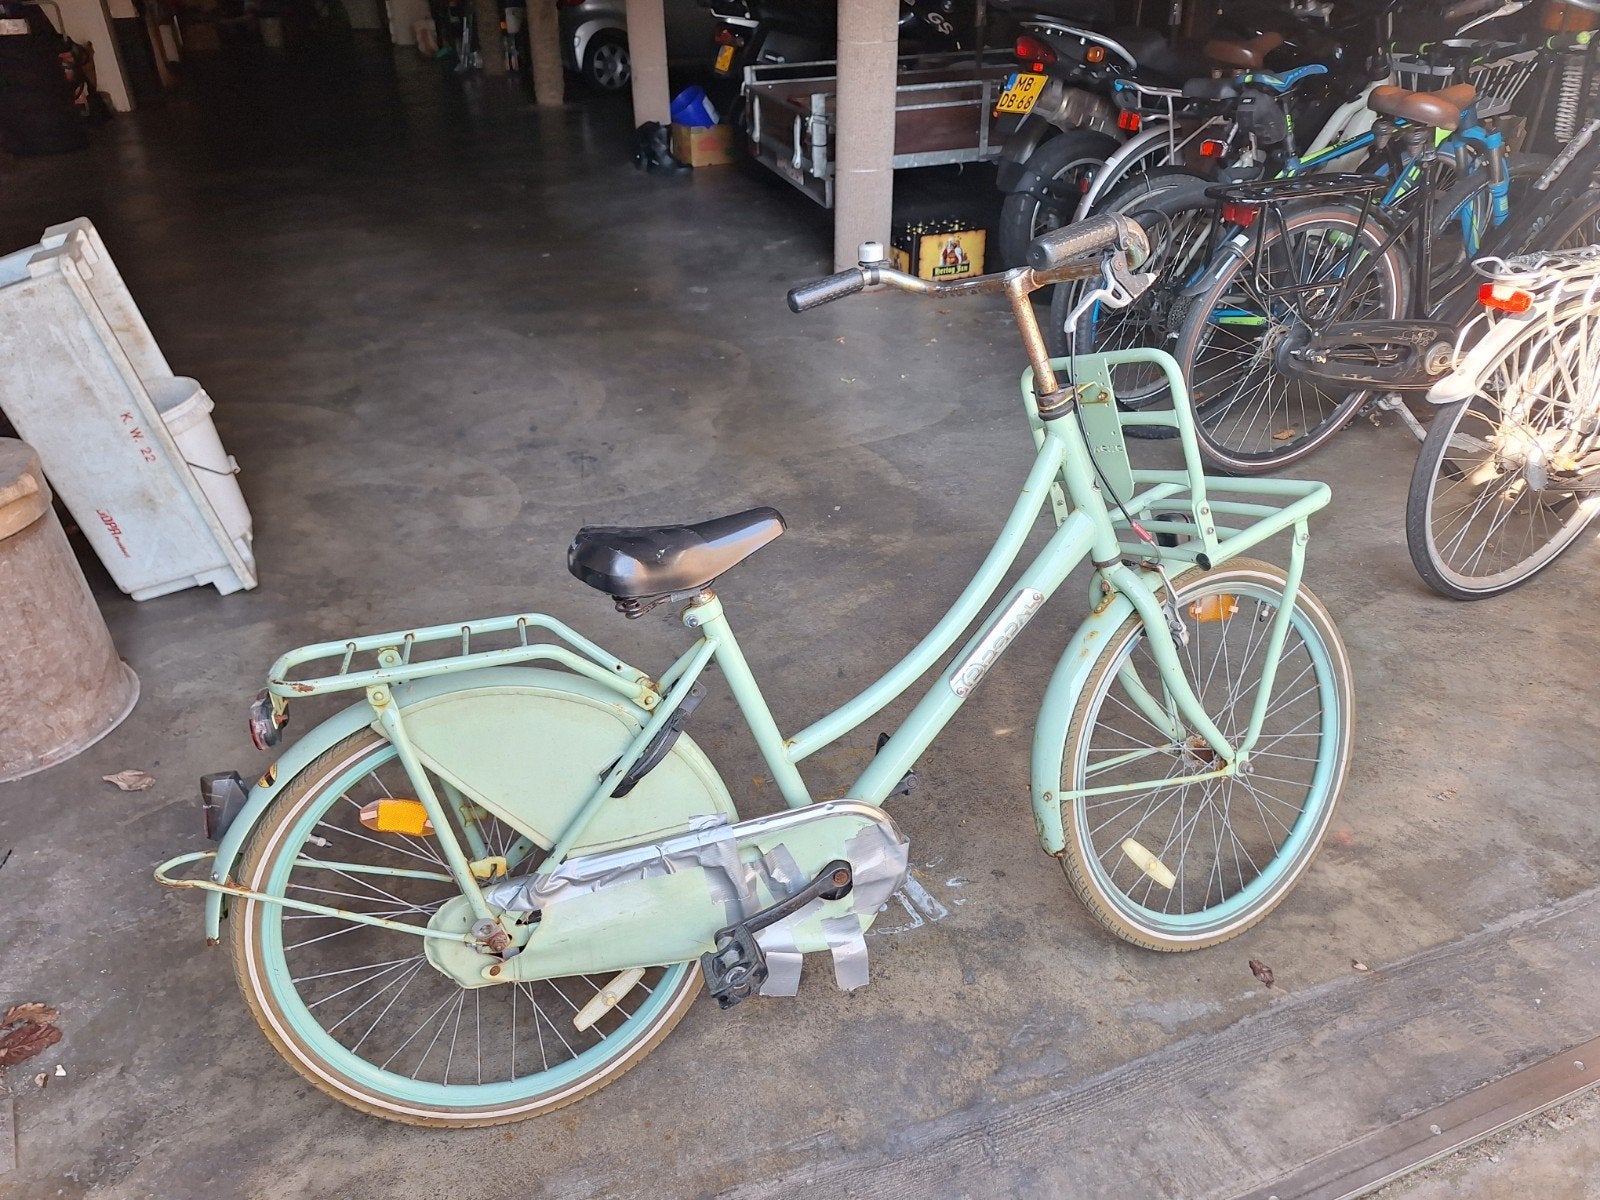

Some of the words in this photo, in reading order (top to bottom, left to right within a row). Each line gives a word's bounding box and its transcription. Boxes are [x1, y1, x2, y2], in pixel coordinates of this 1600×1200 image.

[928, 12, 953, 35] GS
[1014, 77, 1034, 91] MB
[140, 446, 156, 463] 22
